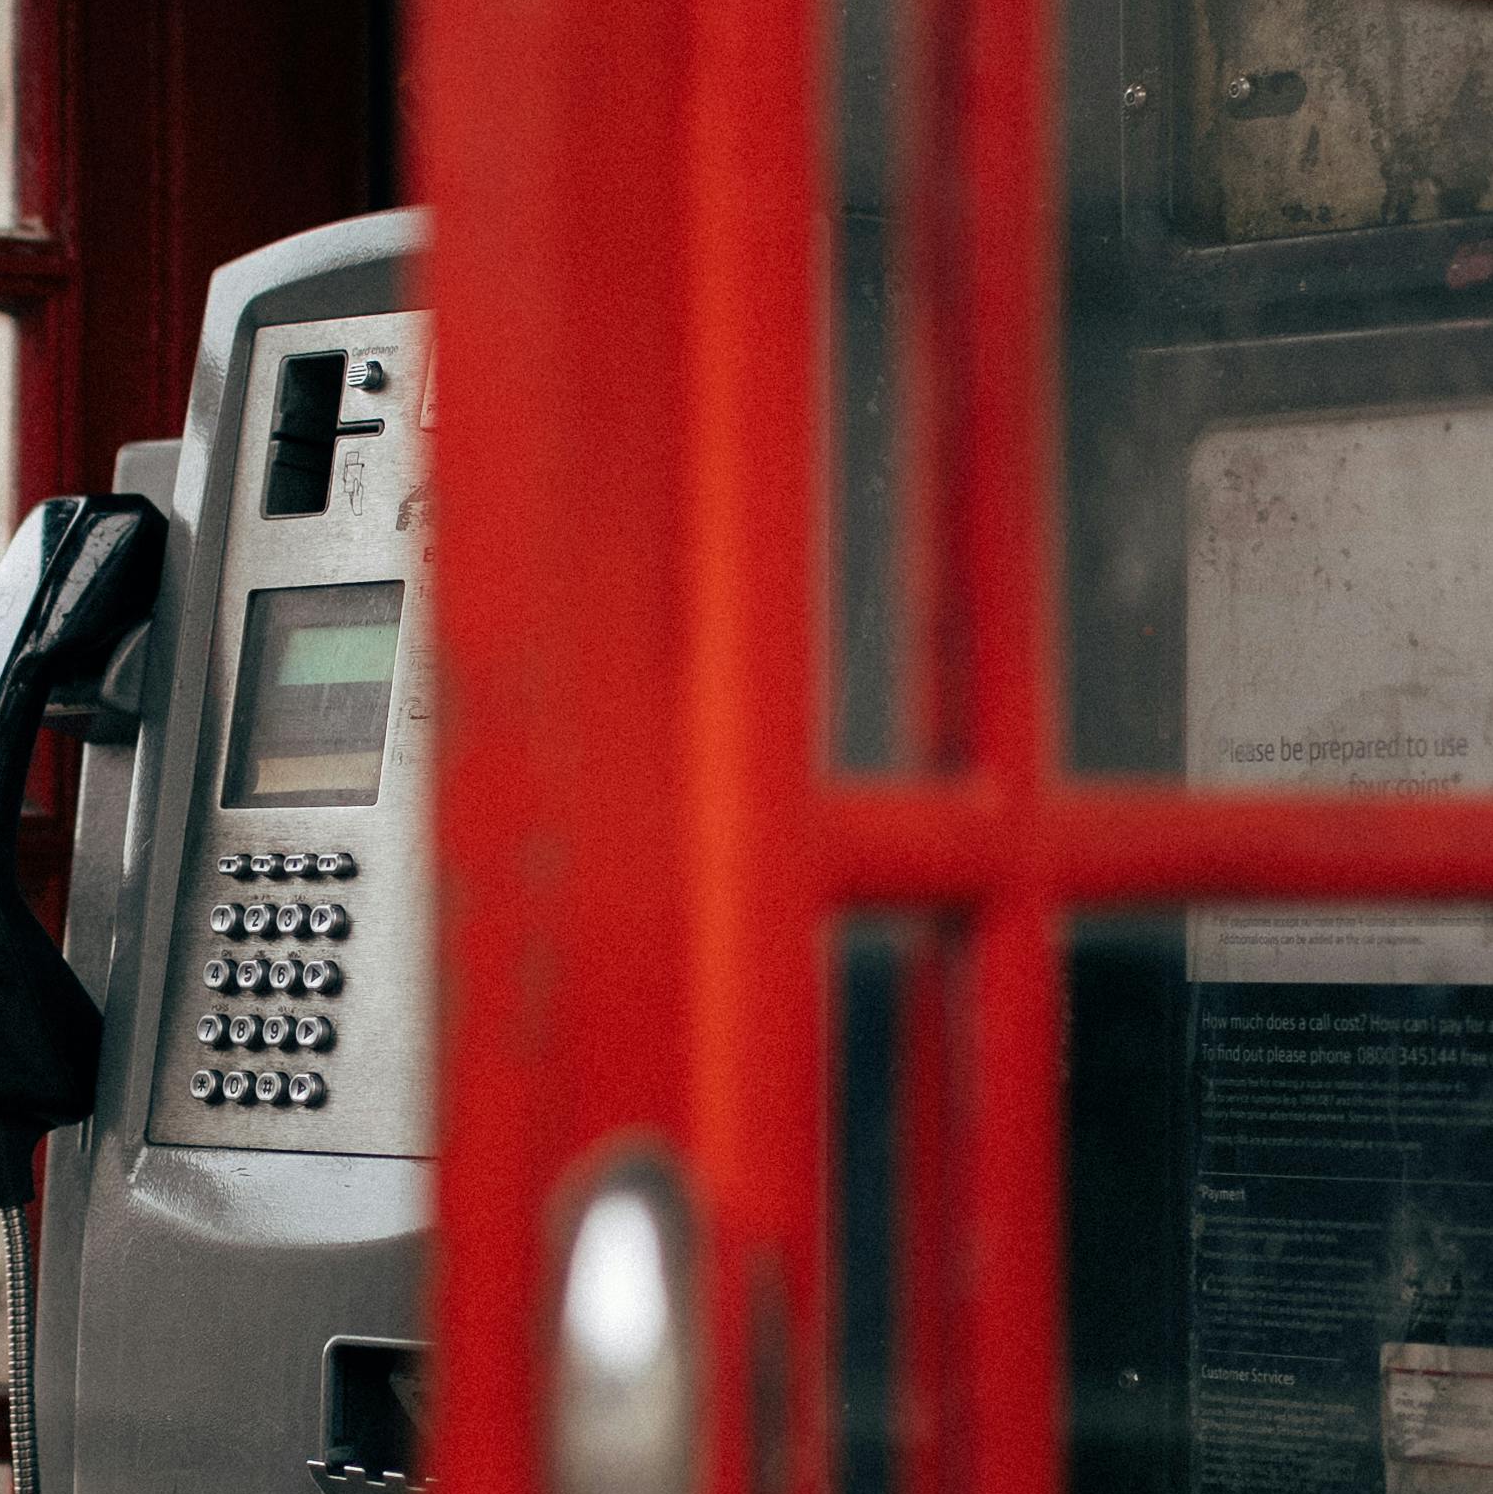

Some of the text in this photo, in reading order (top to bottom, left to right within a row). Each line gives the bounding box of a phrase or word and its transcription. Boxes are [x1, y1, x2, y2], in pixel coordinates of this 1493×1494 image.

[1218, 736, 1469, 764] Please be prepared to use
[252, 910, 260, 927] 2
[284, 910, 292, 926] 3
[211, 966, 285, 984] 4 5 6
[205, 1021, 279, 1039] 7 8 9
[1201, 1011, 1227, 1031] How
[1230, 1012, 1264, 1031] much
[1266, 1012, 1296, 1031] does
[1298, 1018, 1307, 1031] a
[1309, 1012, 1331, 1031] call
[1334, 1013, 1367, 1032] cost?
[1370, 1013, 1400, 1032] How
[1403, 1018, 1428, 1032] can
[1439, 1018, 1462, 1037] pay
[1465, 1014, 1485, 1033] for
[1201, 1043, 1214, 1062] To
[1217, 1043, 1241, 1062] find
[1243, 1046, 1264, 1062] out
[1266, 1046, 1307, 1065] please
[1310, 1046, 1352, 1066] phone
[230, 1077, 239, 1095] 0
[1200, 1184, 1246, 1203] Payment
[1201, 1363, 1296, 1386] Customer Services
